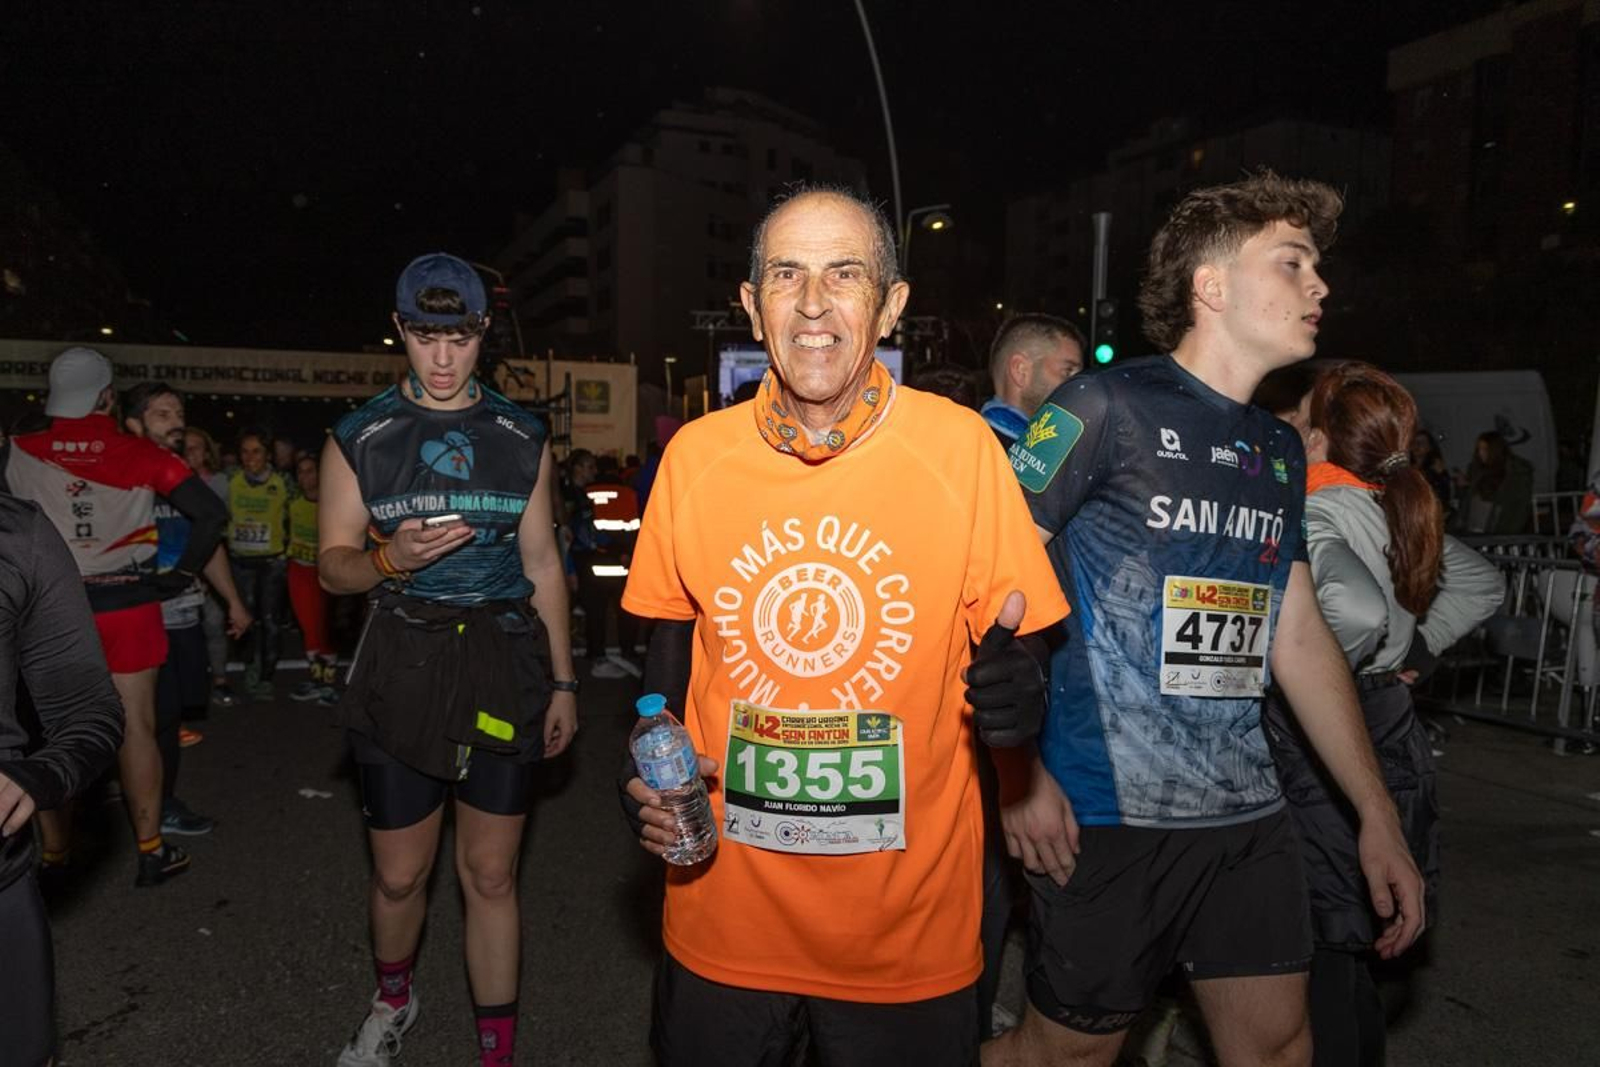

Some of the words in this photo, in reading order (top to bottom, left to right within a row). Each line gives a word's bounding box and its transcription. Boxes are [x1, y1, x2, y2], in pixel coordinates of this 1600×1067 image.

[152, 364, 308, 384] INTERNACIONAL
[313, 369, 368, 385] NOCHE
[417, 495, 446, 511] VIDA
[449, 494, 480, 511] DONA
[1146, 495, 1218, 534] SAN
[730, 518, 805, 583] MÁS
[816, 515, 893, 576] QUE
[778, 567, 843, 592] BEER
[713, 586, 780, 708] MUCHO
[760, 629, 857, 673] RUNNERS
[831, 574, 915, 711] CORRER
[1175, 612, 1263, 653] 4737
[753, 714, 781, 741] 42
[782, 730, 805, 741] SAN
[736, 745, 886, 800] 1355
[764, 800, 783, 811] JUAN
[785, 802, 818, 812] FLORIDO
